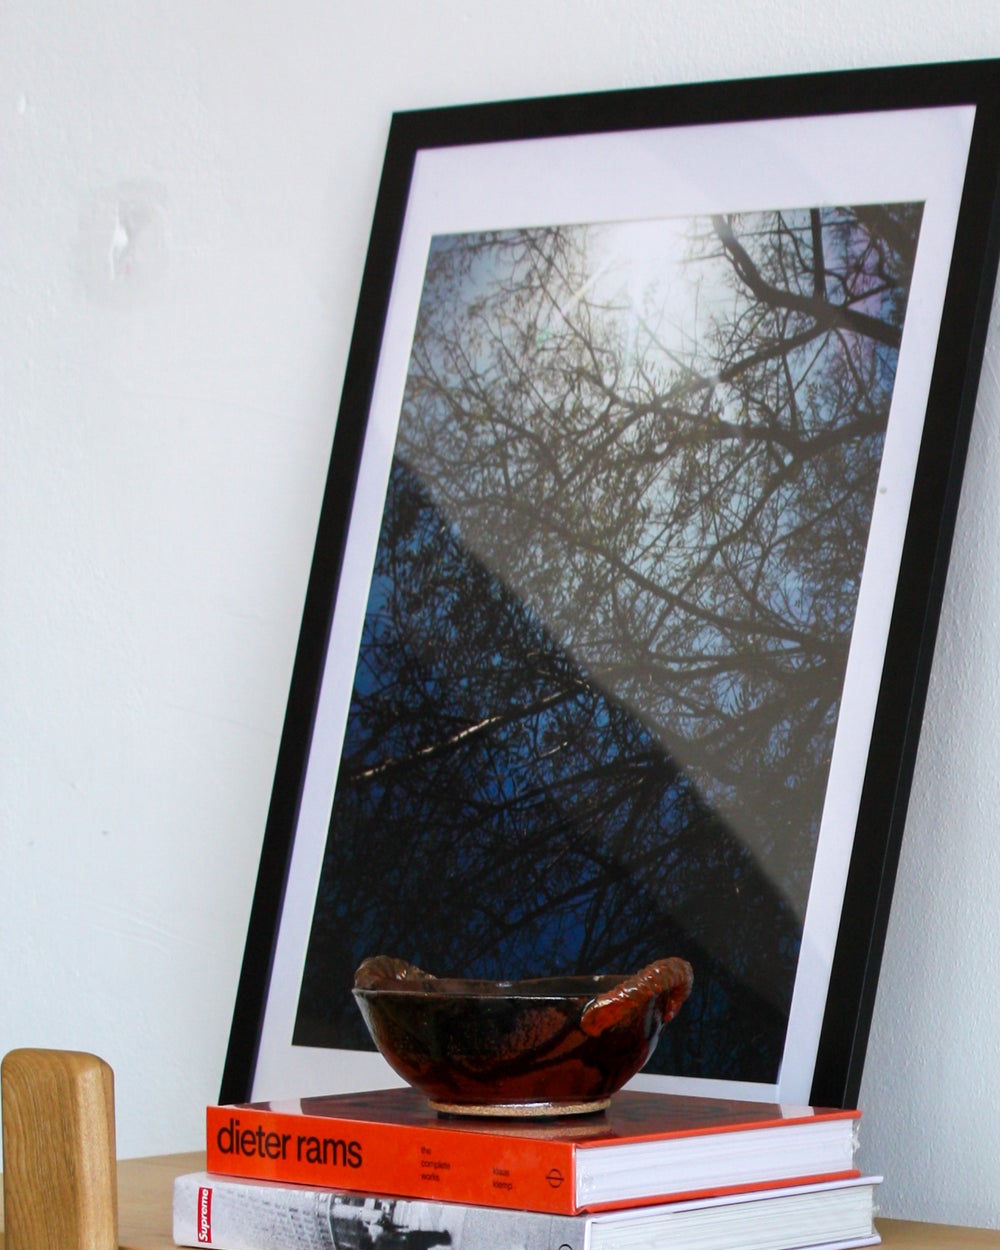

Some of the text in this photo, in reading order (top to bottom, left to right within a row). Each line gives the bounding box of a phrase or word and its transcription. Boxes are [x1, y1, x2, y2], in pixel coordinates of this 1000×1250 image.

[217, 1118, 363, 1169] dieter rams
[198, 1188, 210, 1242] Supreme
